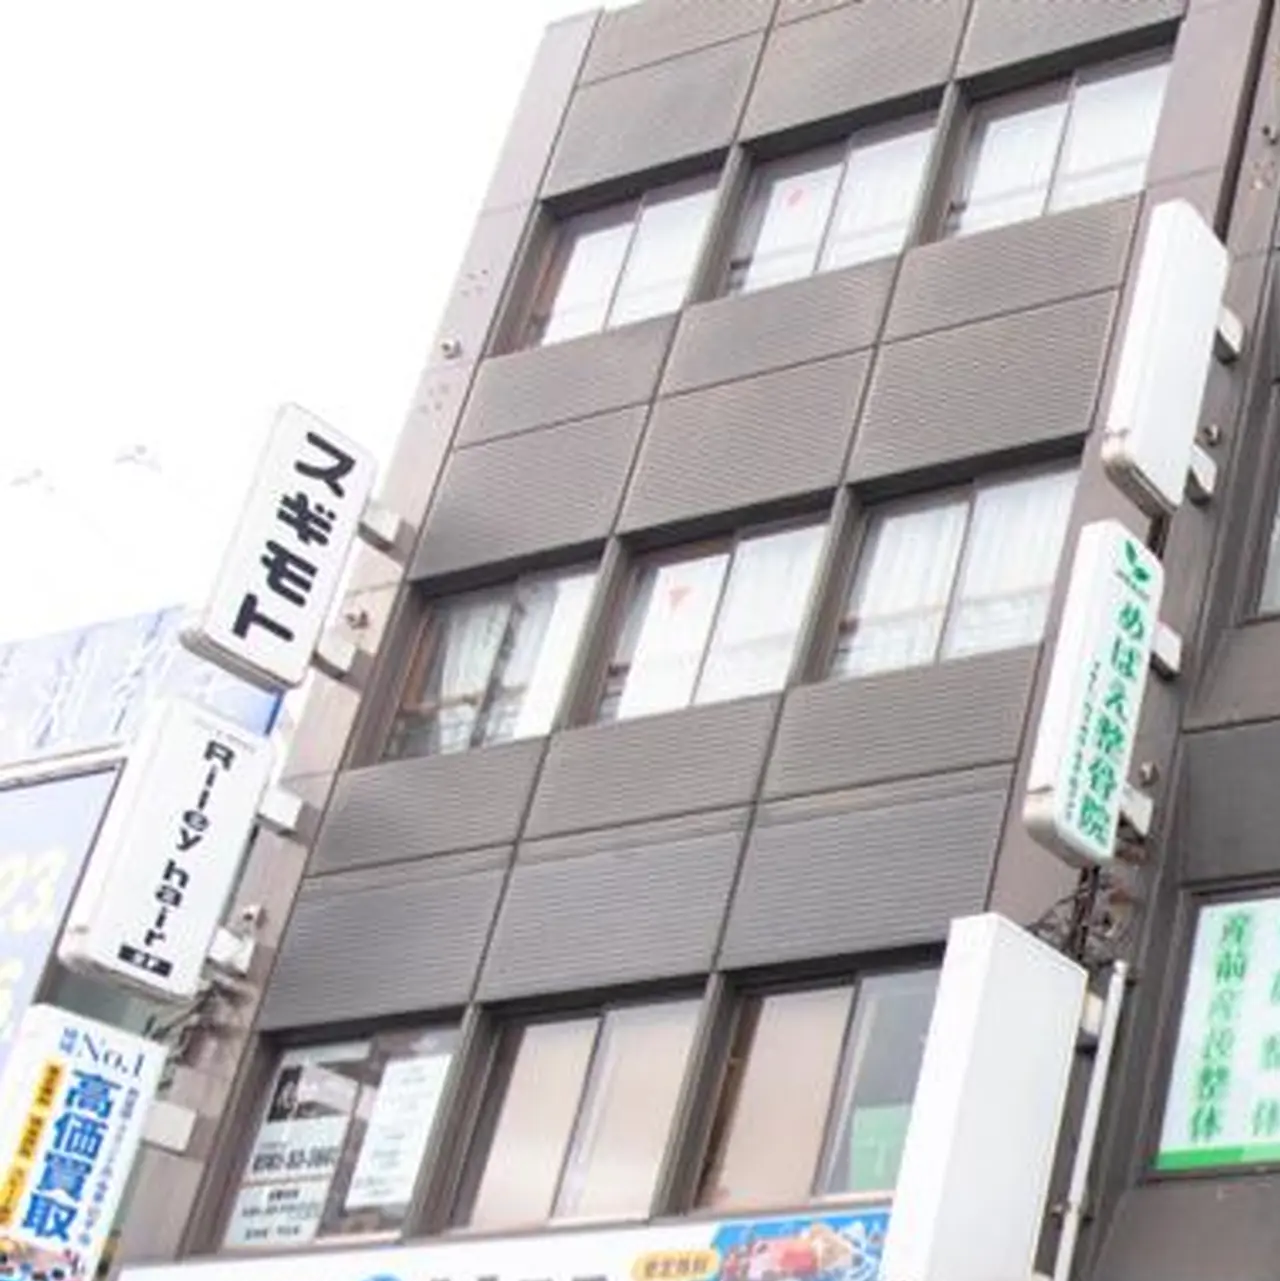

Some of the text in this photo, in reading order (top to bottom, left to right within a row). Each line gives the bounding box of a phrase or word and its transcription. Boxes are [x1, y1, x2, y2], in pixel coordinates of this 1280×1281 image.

[233, 431, 357, 643] スギモト
[144, 859, 190, 946] hair
[20, 1068, 122, 1244] 高価買取
